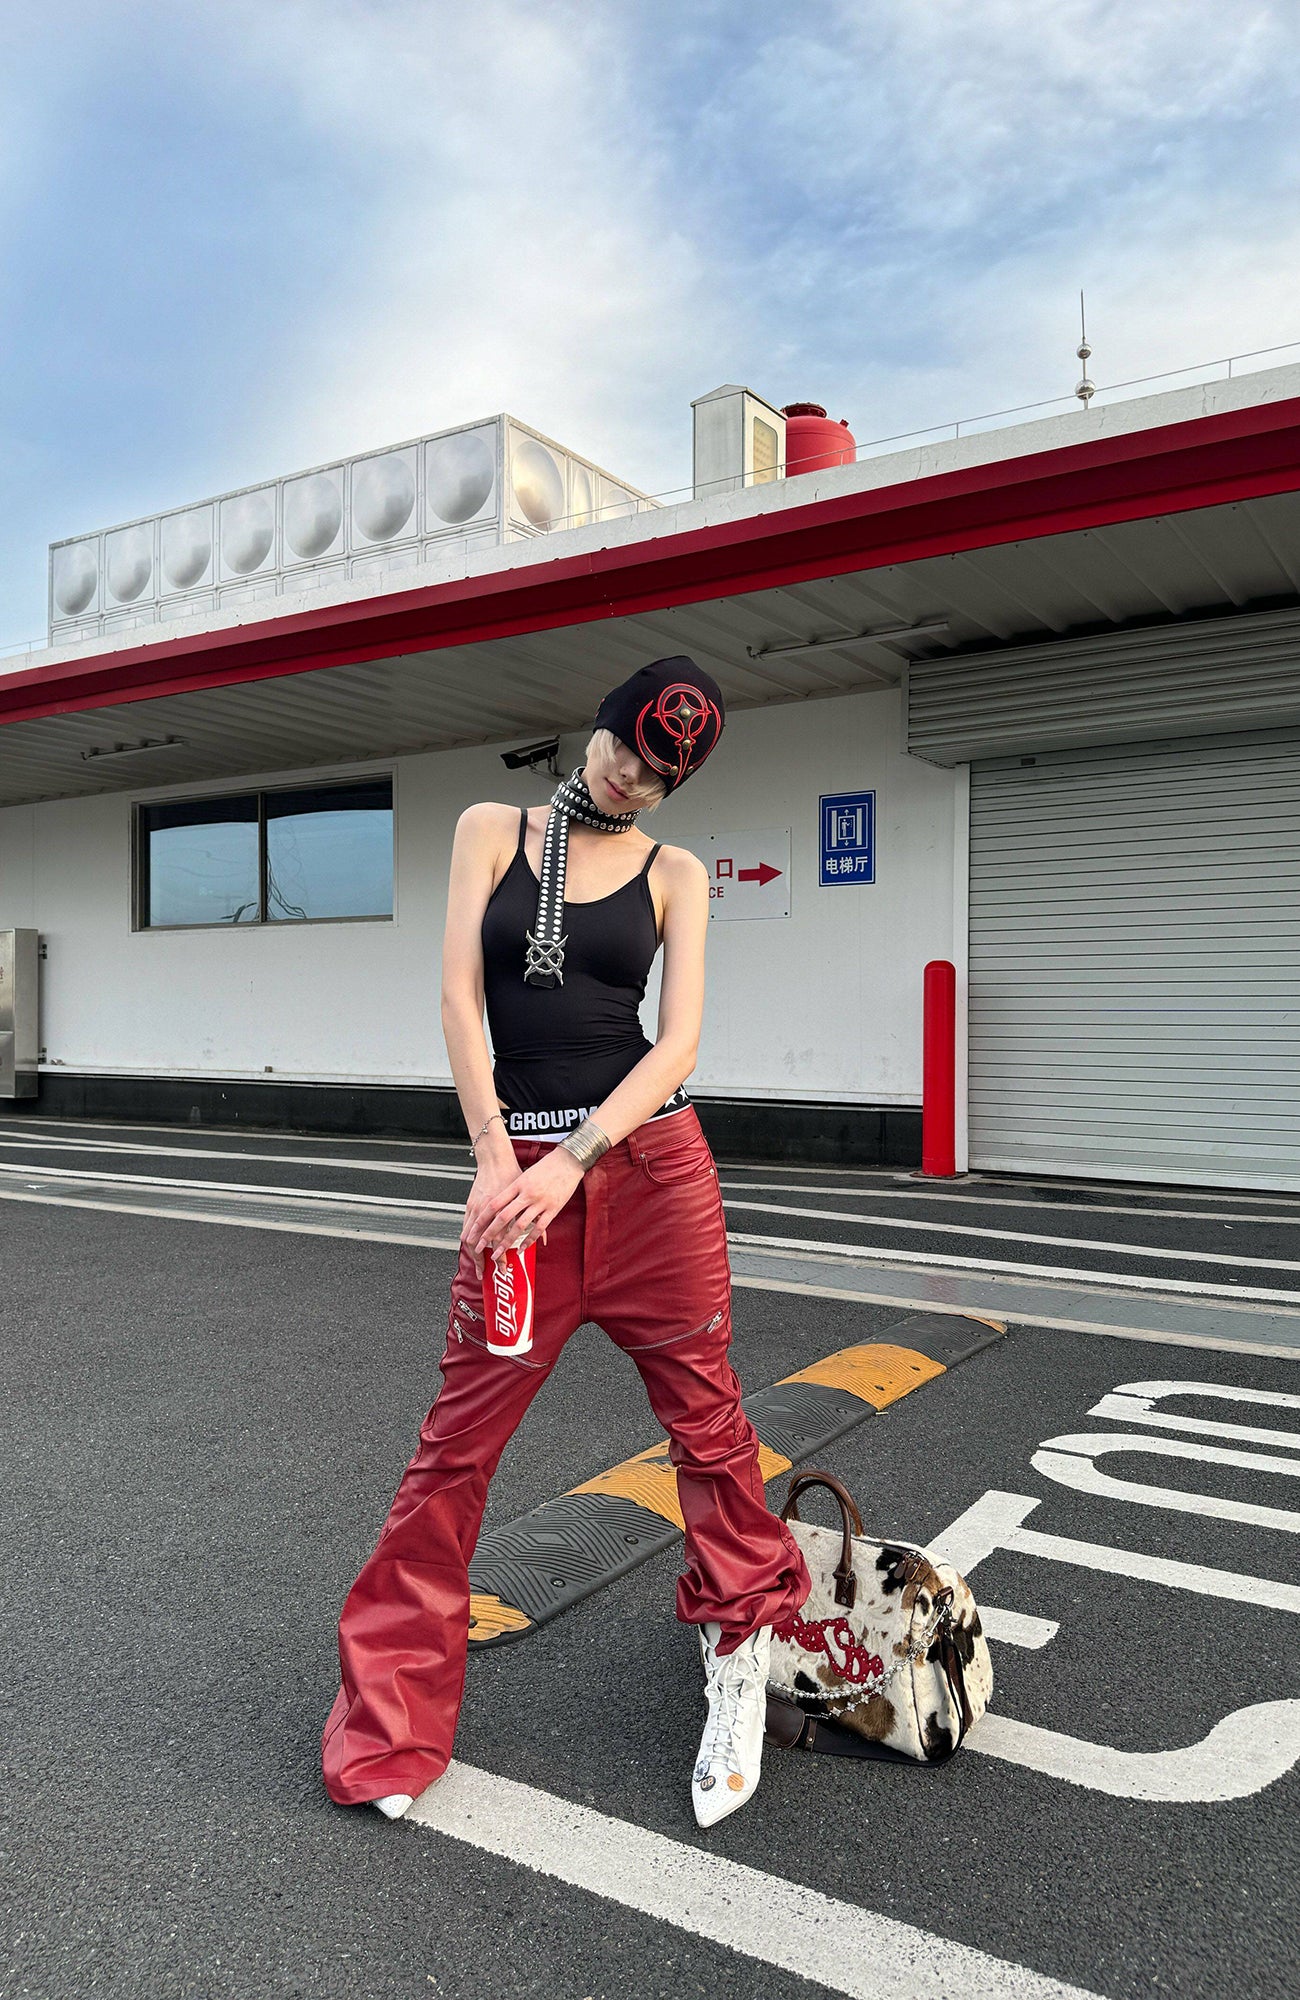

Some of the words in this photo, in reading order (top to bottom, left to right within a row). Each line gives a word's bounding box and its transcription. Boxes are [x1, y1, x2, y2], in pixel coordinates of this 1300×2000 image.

[709, 858, 733, 879] 口
[825, 856, 868, 875] 电梯厅
